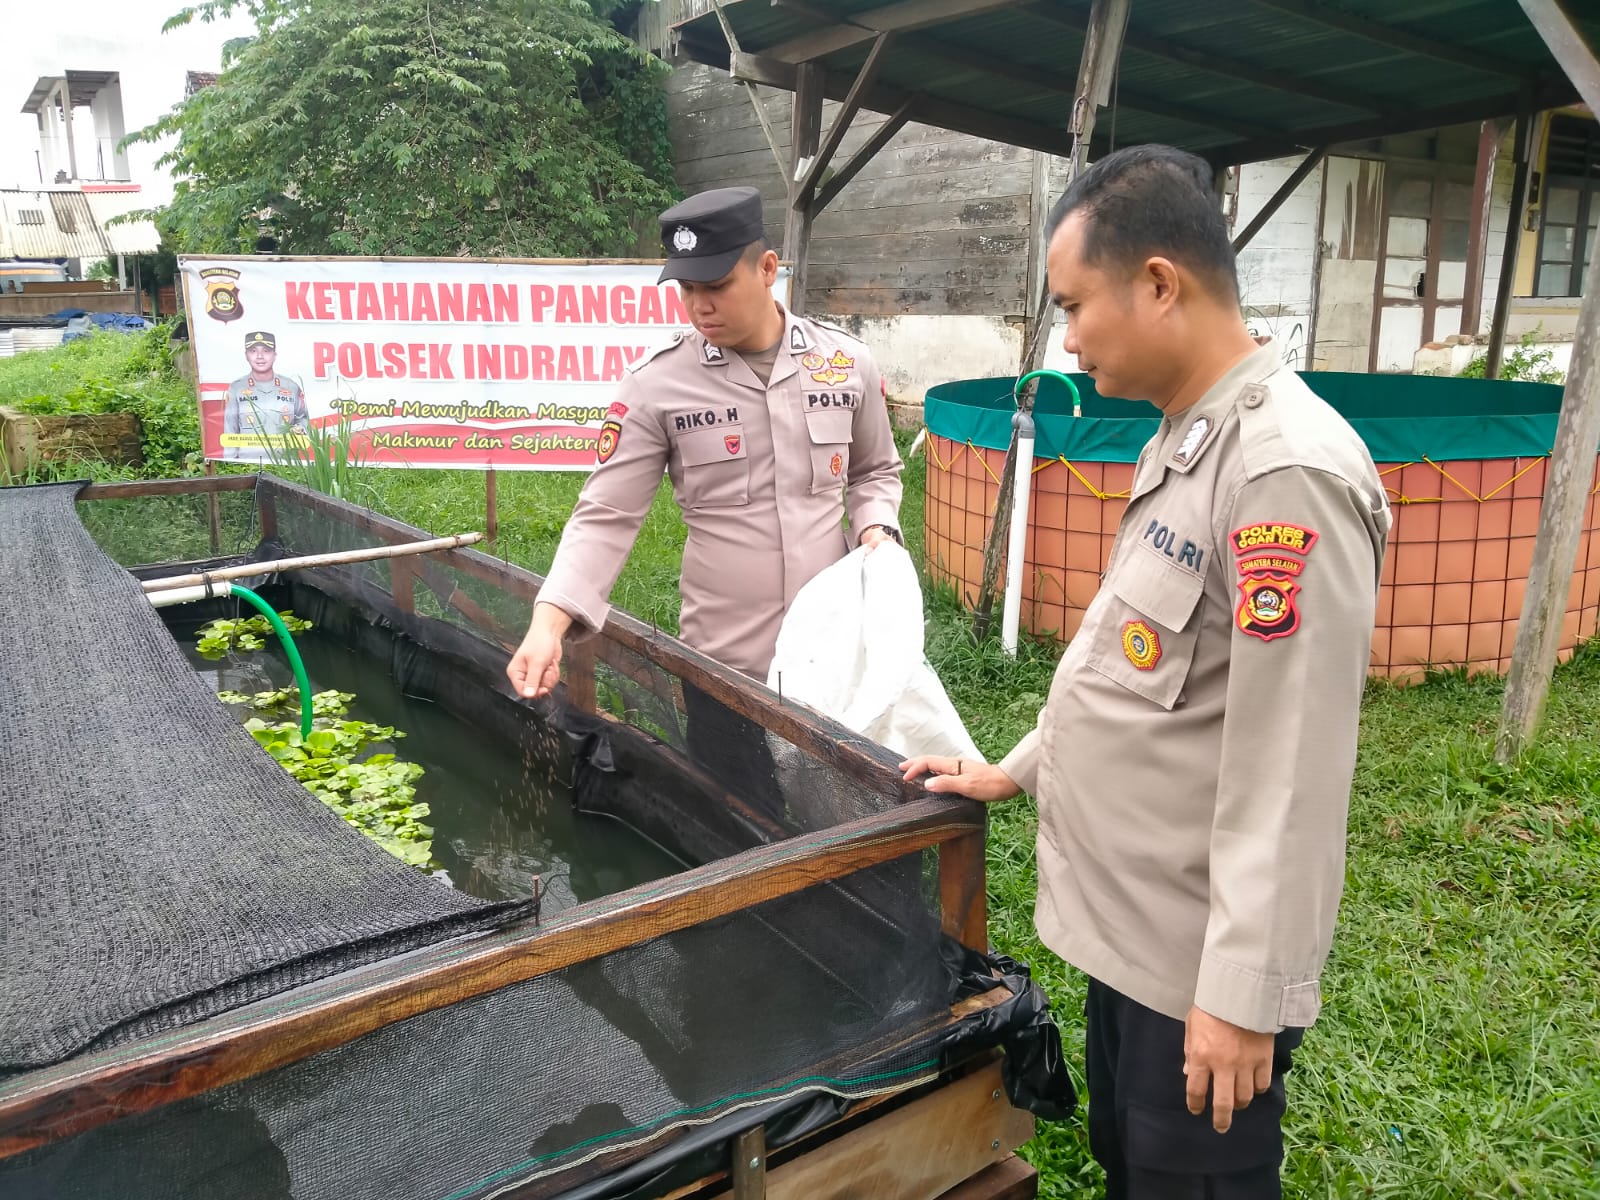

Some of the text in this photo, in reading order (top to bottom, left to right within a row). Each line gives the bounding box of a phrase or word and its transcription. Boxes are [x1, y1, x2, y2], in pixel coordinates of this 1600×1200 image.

[285, 281, 690, 324] KETAHANAN PANGAN
[313, 342, 455, 379] POLSEK
[808, 392, 855, 408] POLRI
[401, 401, 530, 424] Mewujudkan
[675, 408, 738, 430] RIKO. H
[372, 430, 458, 449] Makmur
[464, 432, 504, 449] dan
[1239, 534, 1275, 548] OGAN
[1240, 525, 1304, 539] POLRES
[1144, 519, 1204, 572] POLRI
[1241, 558, 1271, 571] SUMATERA
